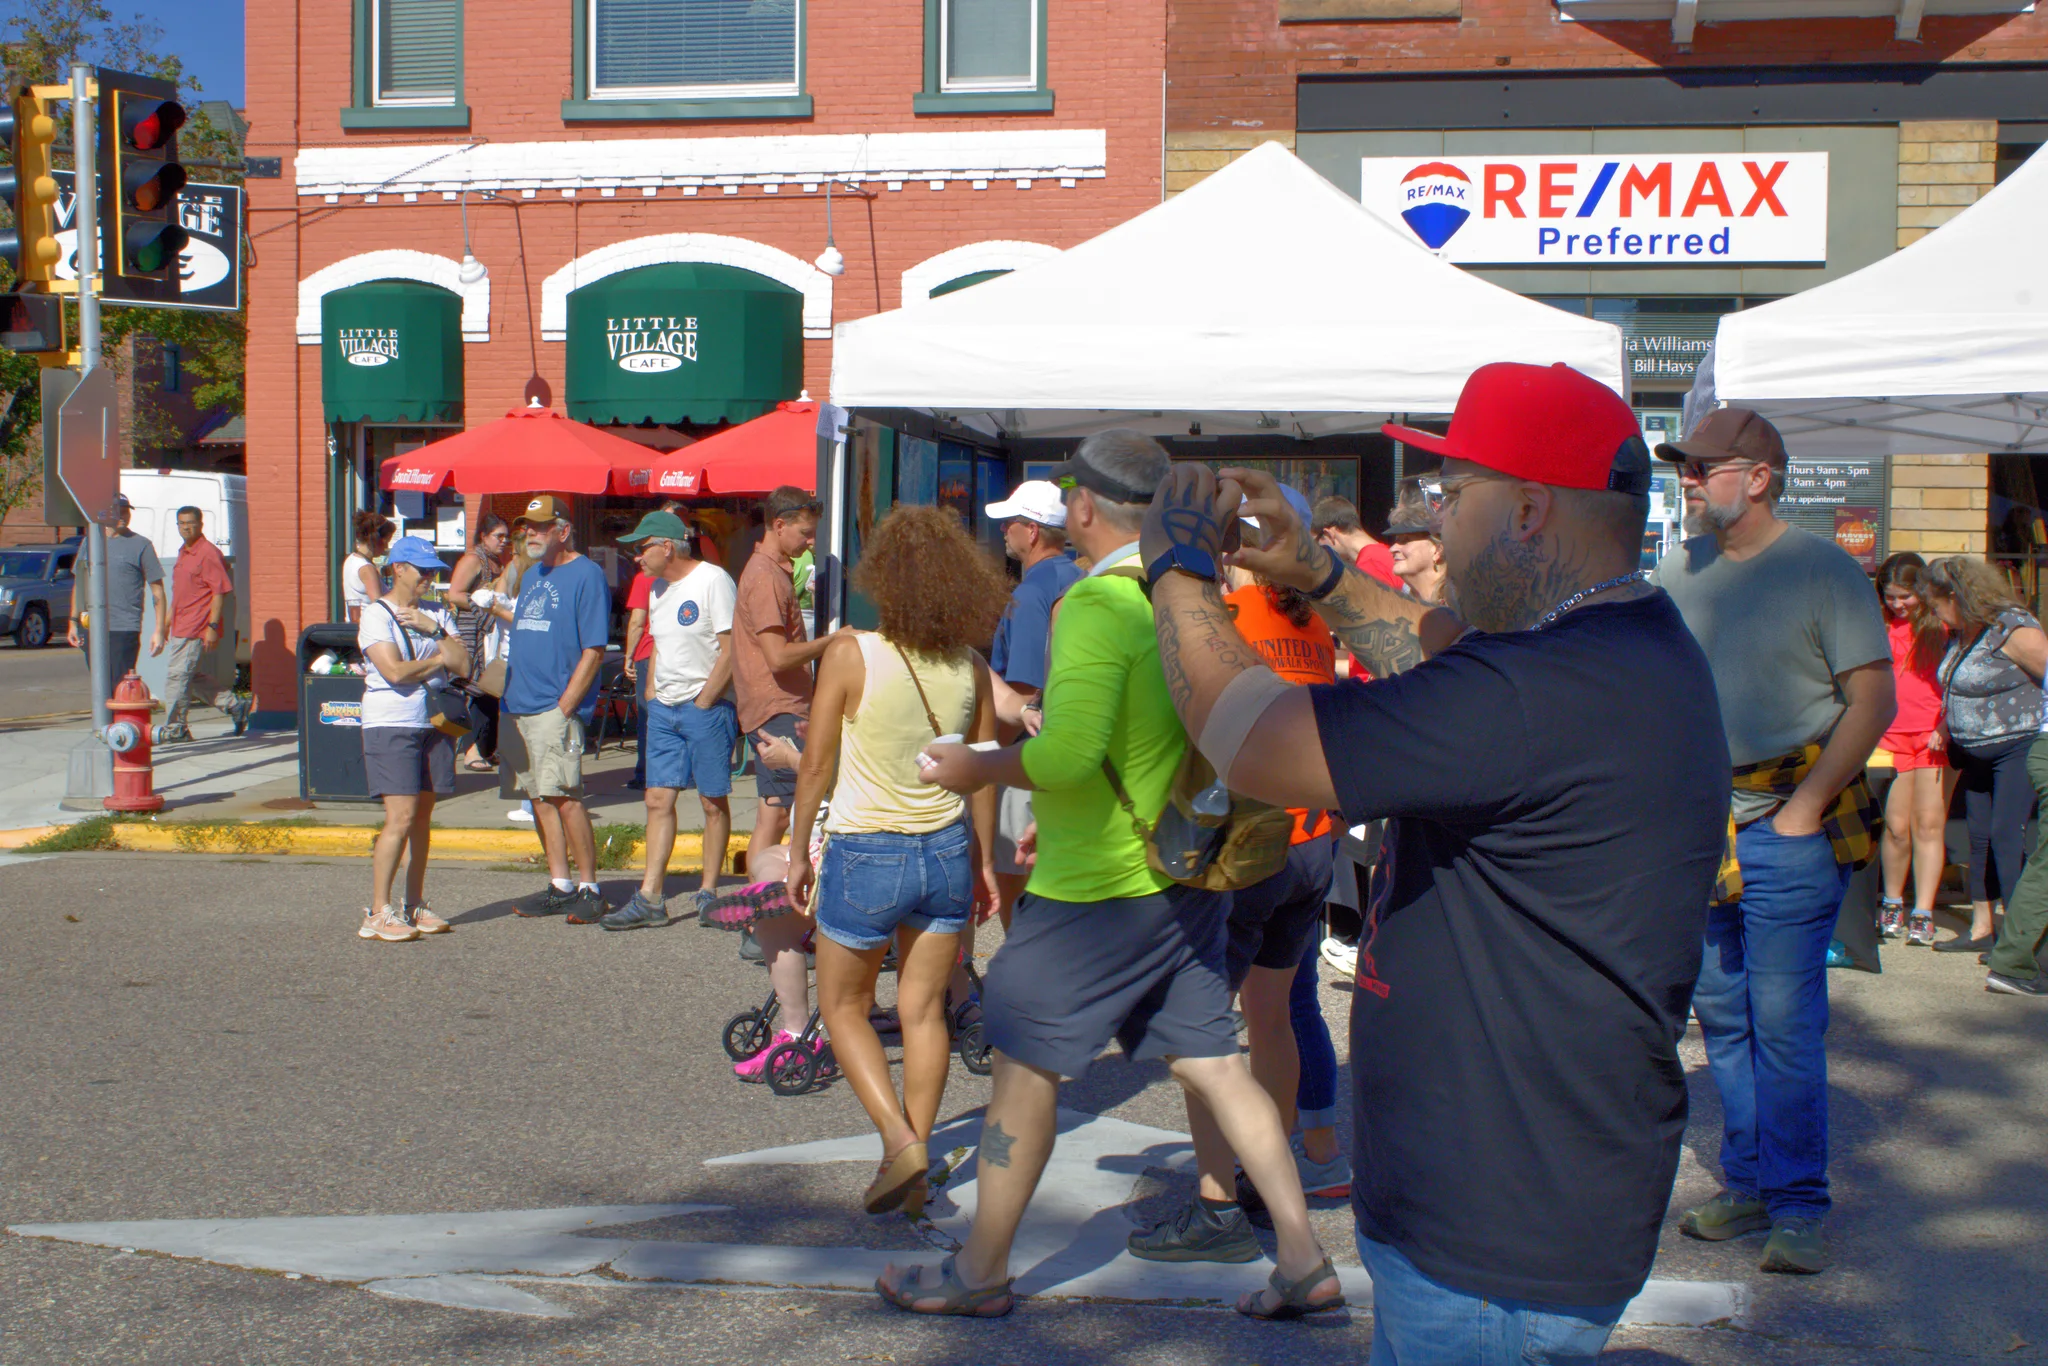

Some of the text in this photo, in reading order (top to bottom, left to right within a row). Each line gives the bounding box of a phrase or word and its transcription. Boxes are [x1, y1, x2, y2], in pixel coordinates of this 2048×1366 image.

[1407, 183, 1466, 201] RE/MAX
[1483, 161, 1789, 219] RE/MAX
[1538, 227, 1730, 255] Preferred
[606, 316, 698, 330] LITTLE
[339, 329, 399, 338] LITTLE
[339, 338, 399, 359] VILLAGE
[606, 331, 698, 362] VILLAGE
[354, 356, 382, 364] CAFE
[629, 358, 671, 369] CAFE
[1634, 358, 1695, 375] Bill Hays
[1787, 465, 1815, 474] Thurs
[1816, 466, 1838, 474] 9am
[1847, 466, 1869, 477] 5pm
[1793, 478, 1814, 487] 9am
[1824, 478, 1846, 489] 4pm
[1787, 495, 1796, 504] by
[1798, 495, 1846, 504] appointment
[543, 581, 560, 609] BLUFF
[1252, 638, 1311, 657] UNITED
